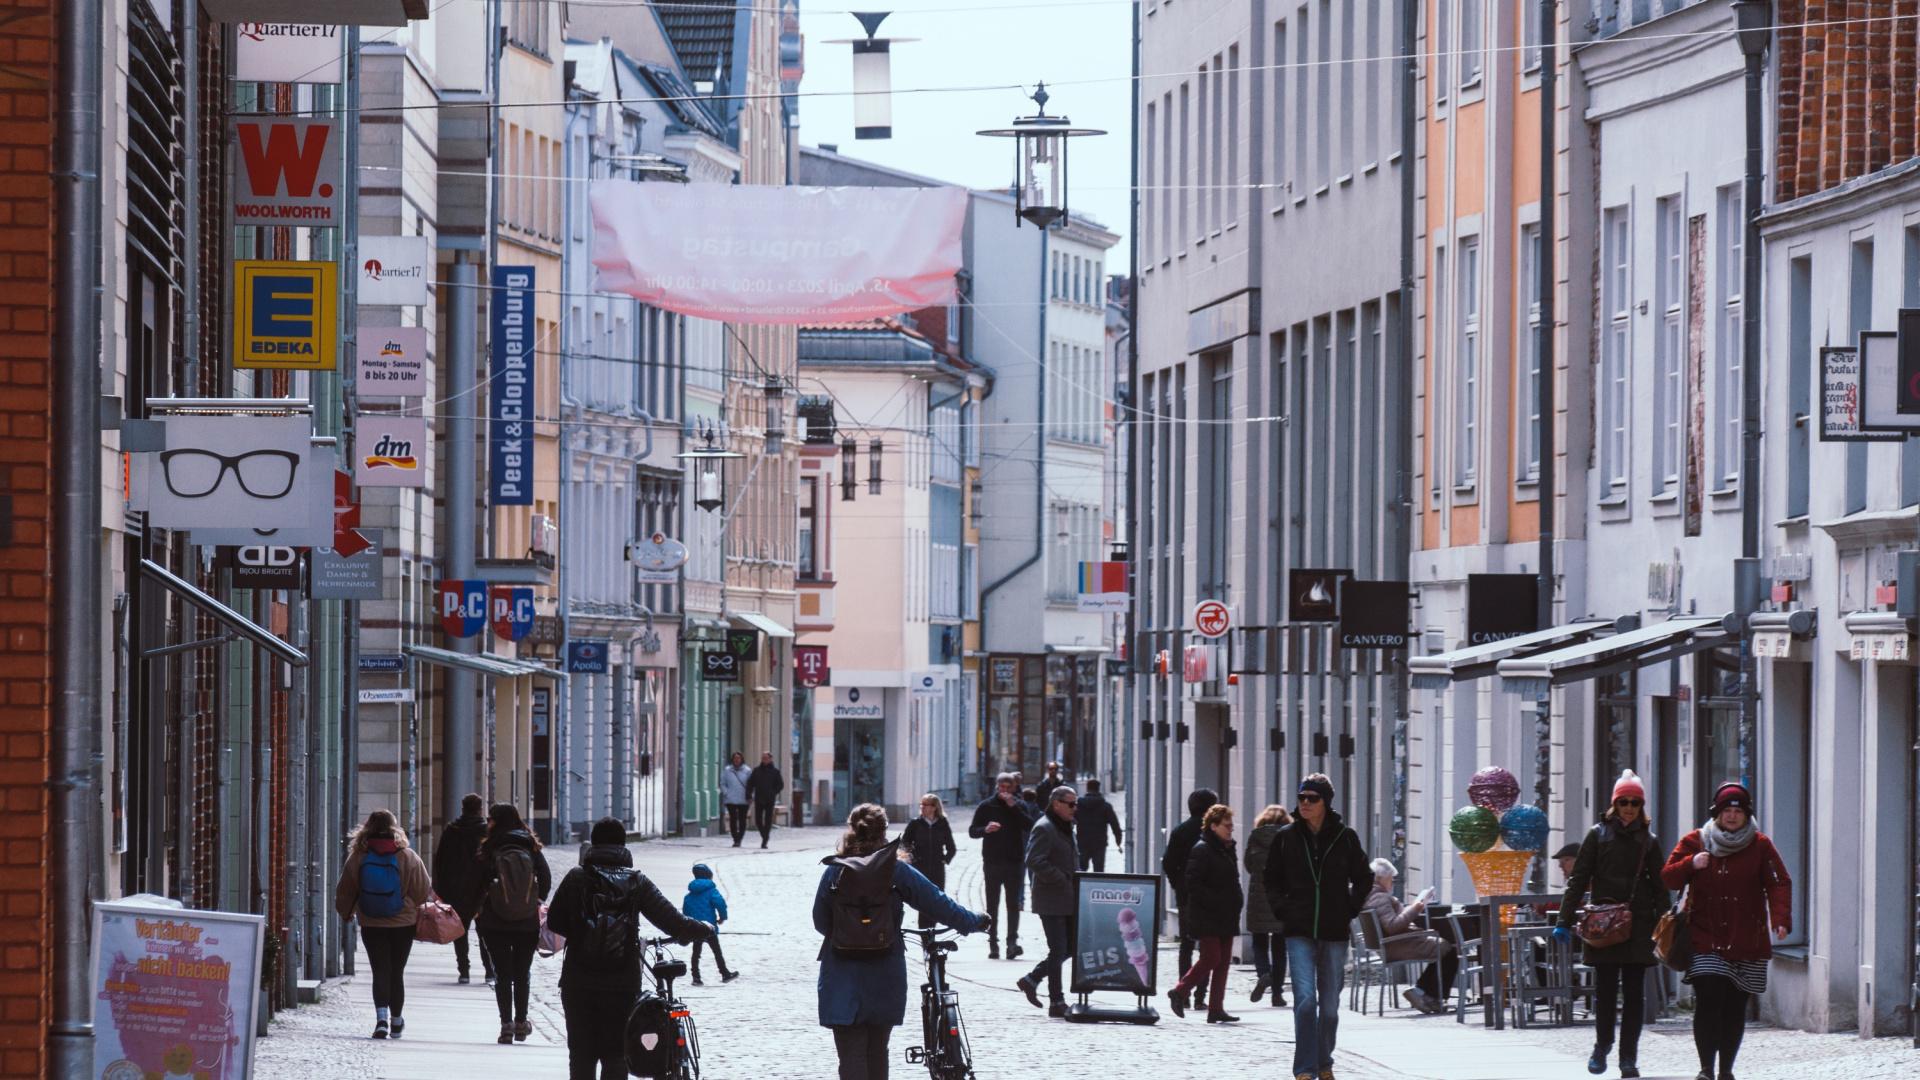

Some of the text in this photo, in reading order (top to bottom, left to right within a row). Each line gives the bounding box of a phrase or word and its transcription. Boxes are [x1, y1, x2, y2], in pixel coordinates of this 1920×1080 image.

[235, 205, 331, 219] WOOLWORTH
[251, 341, 314, 354] EDEKA
[384, 340, 401, 351] dm
[362, 360, 387, 370] Montag
[392, 361, 421, 369] Samstag
[365, 371, 418, 381] 8 bis 20 Uhr
[374, 434, 412, 457] dm
[239, 567, 293, 576] BIJOU BRIGITTE
[443, 591, 484, 619] P&C
[494, 598, 531, 624] P&C
[1343, 634, 1404, 645] CANVERO
[572, 660, 602, 670] Apollo
[135, 918, 204, 943] Verkäufer
[1081, 946, 1120, 969] EIS
[137, 955, 232, 981] nicht backen!
